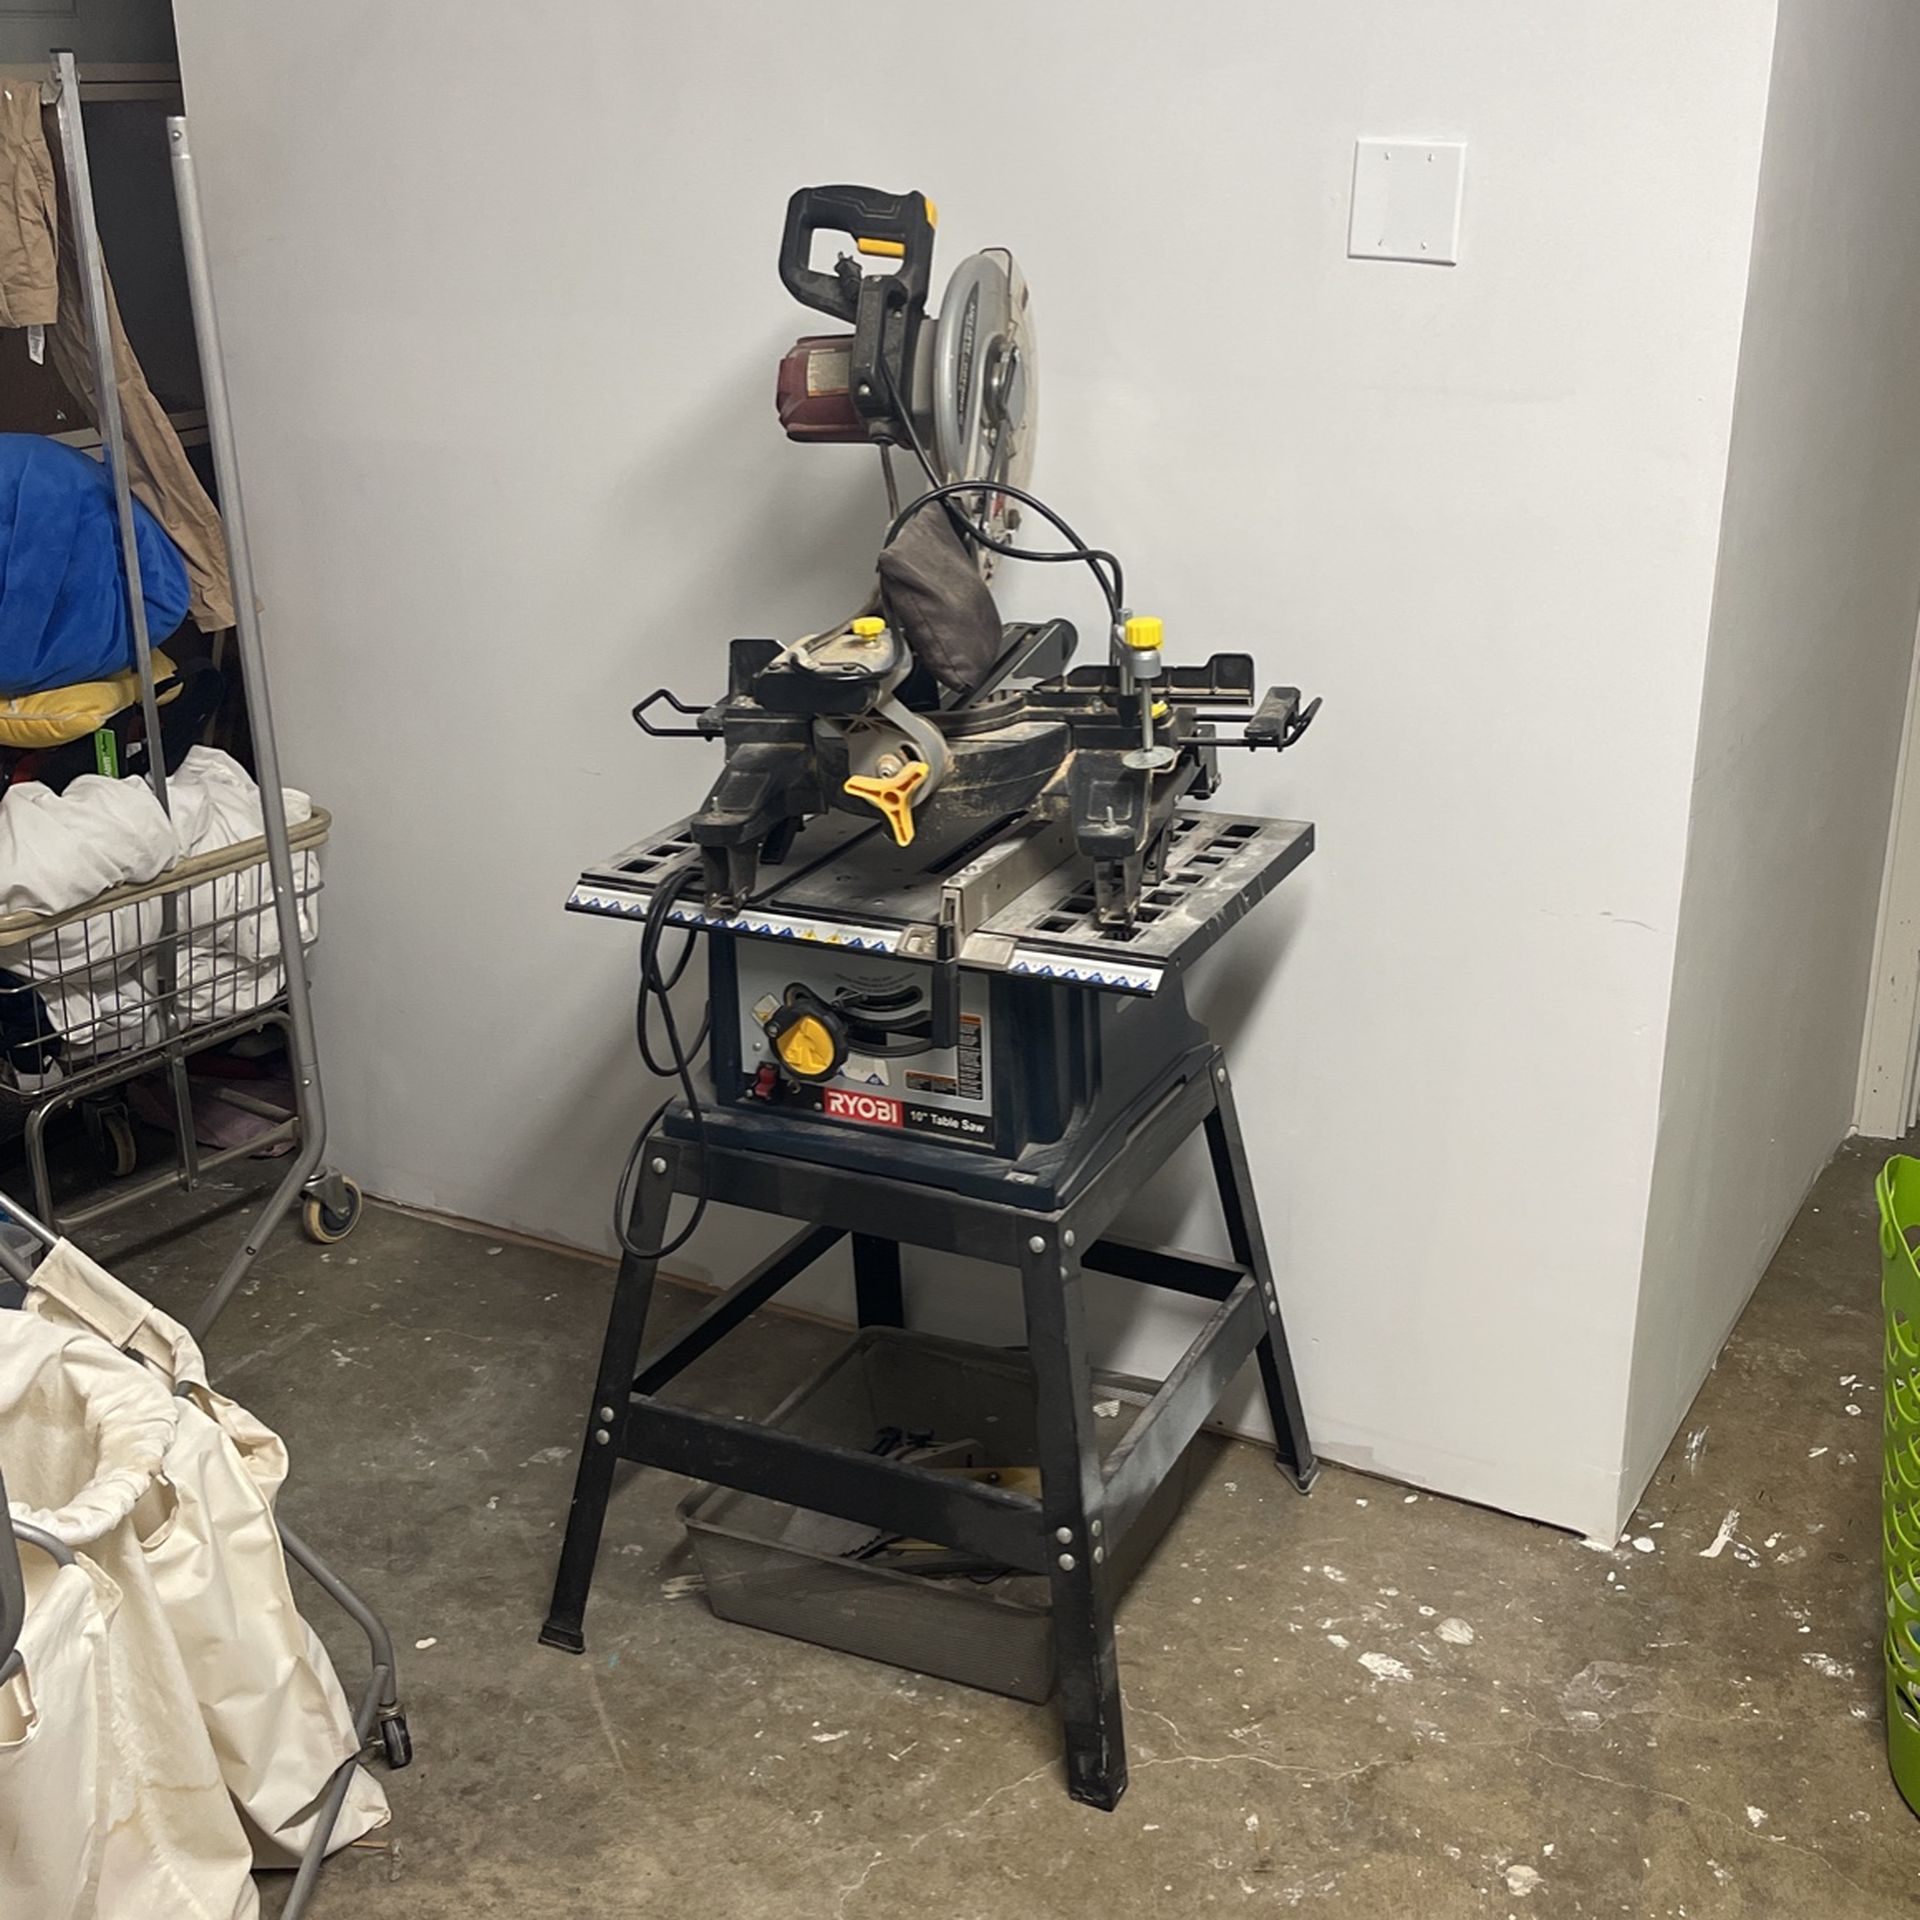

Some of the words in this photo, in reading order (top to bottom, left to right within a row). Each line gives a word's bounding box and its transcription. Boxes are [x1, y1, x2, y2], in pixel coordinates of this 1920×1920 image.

[828, 1092, 897, 1122] RYOBI
[930, 1113, 960, 1129] Table
[961, 1119, 985, 1133] Saw
